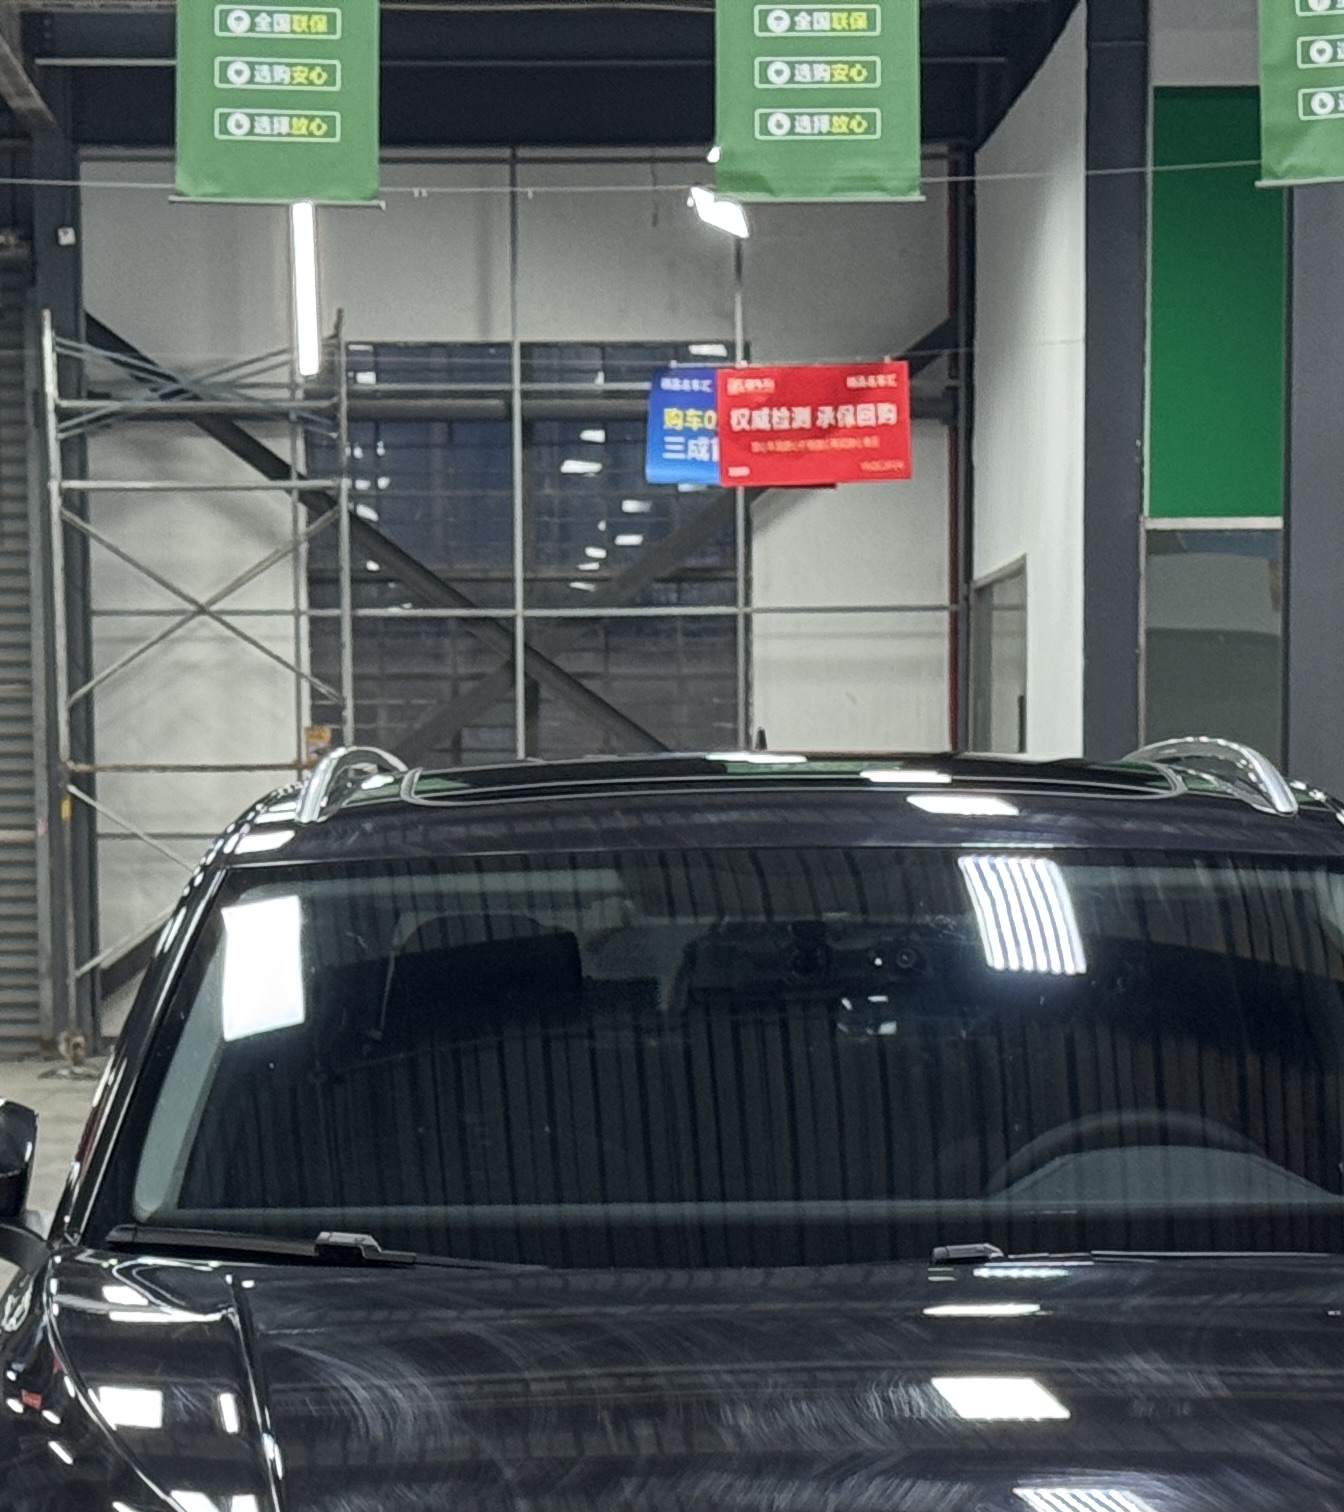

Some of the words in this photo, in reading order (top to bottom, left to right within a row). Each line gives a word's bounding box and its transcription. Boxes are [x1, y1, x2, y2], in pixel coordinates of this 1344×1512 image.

[254, 12, 328, 32] 全国联保
[794, 11, 868, 31] 全国联保
[254, 65, 328, 85] 选购安心
[794, 64, 868, 82] 选购安心
[730, 406, 812, 431] 权威检测
